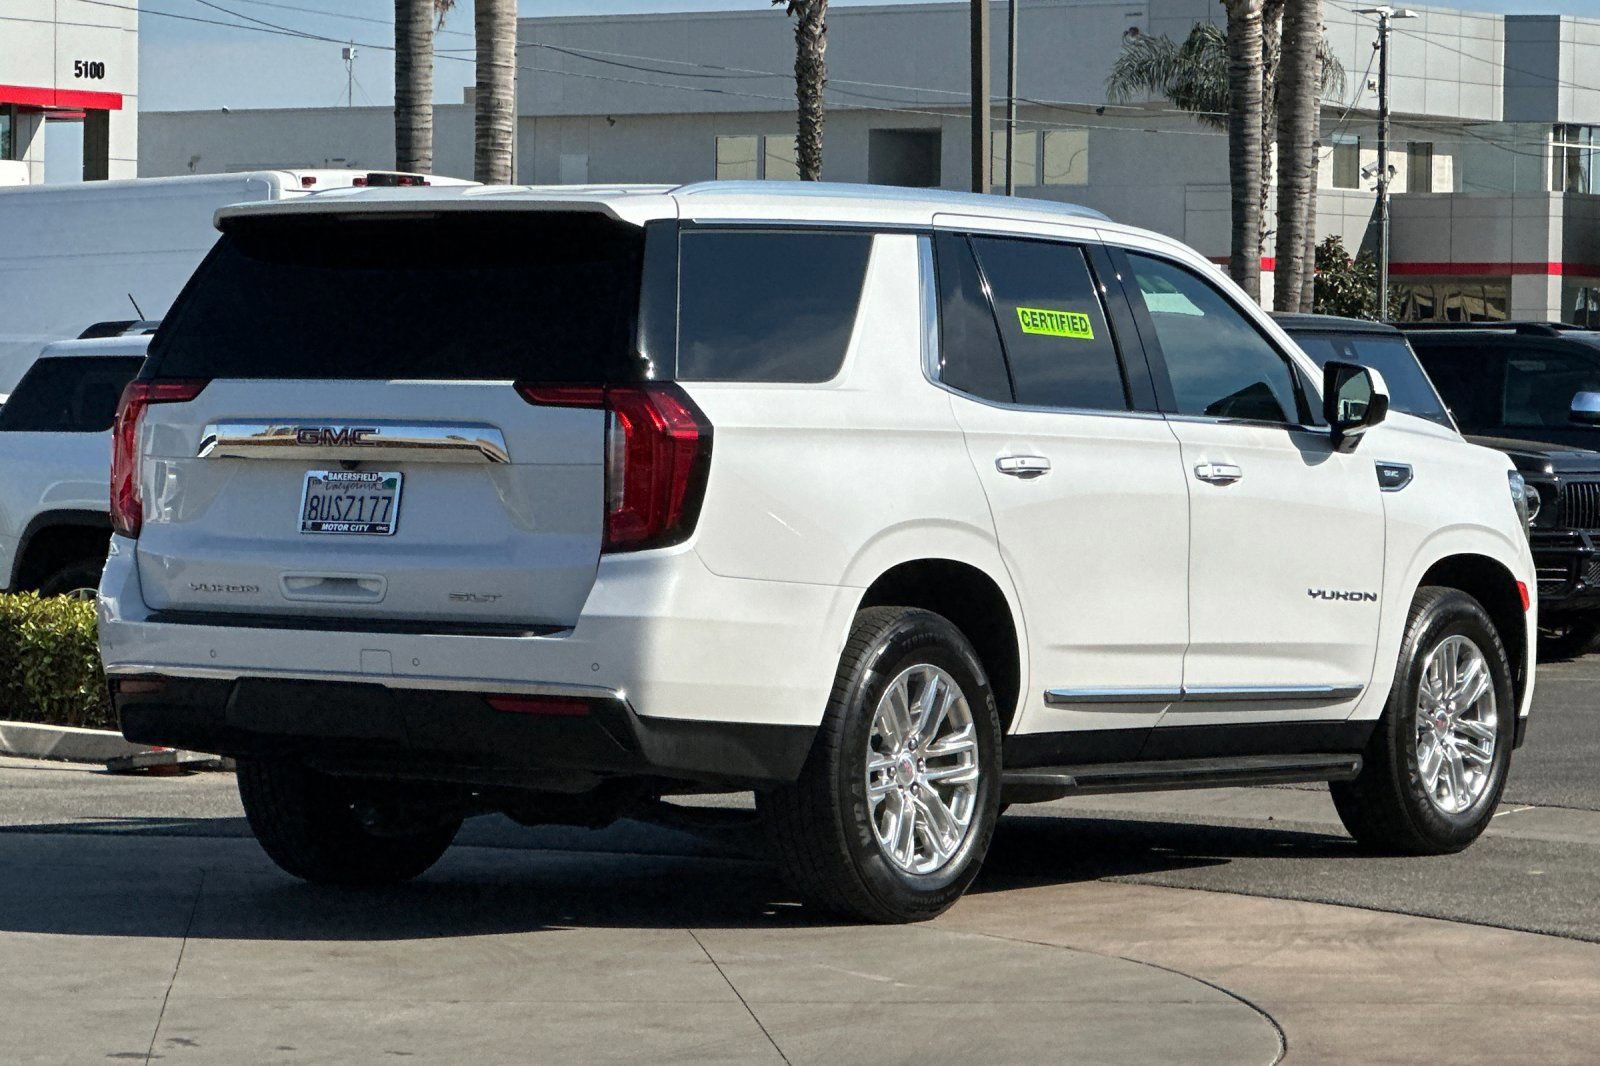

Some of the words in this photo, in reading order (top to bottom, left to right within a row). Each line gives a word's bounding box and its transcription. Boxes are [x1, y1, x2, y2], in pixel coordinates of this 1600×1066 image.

[74, 60, 105, 80] 5100
[1020, 310, 1089, 333] CERTIFIED
[296, 426, 380, 447] GMC
[328, 472, 378, 481] BAKERSFIELD
[308, 495, 392, 522] 8USZ177
[321, 523, 349, 531] MOTOR
[350, 524, 369, 532] CITY
[1307, 588, 1378, 602] YUKON
